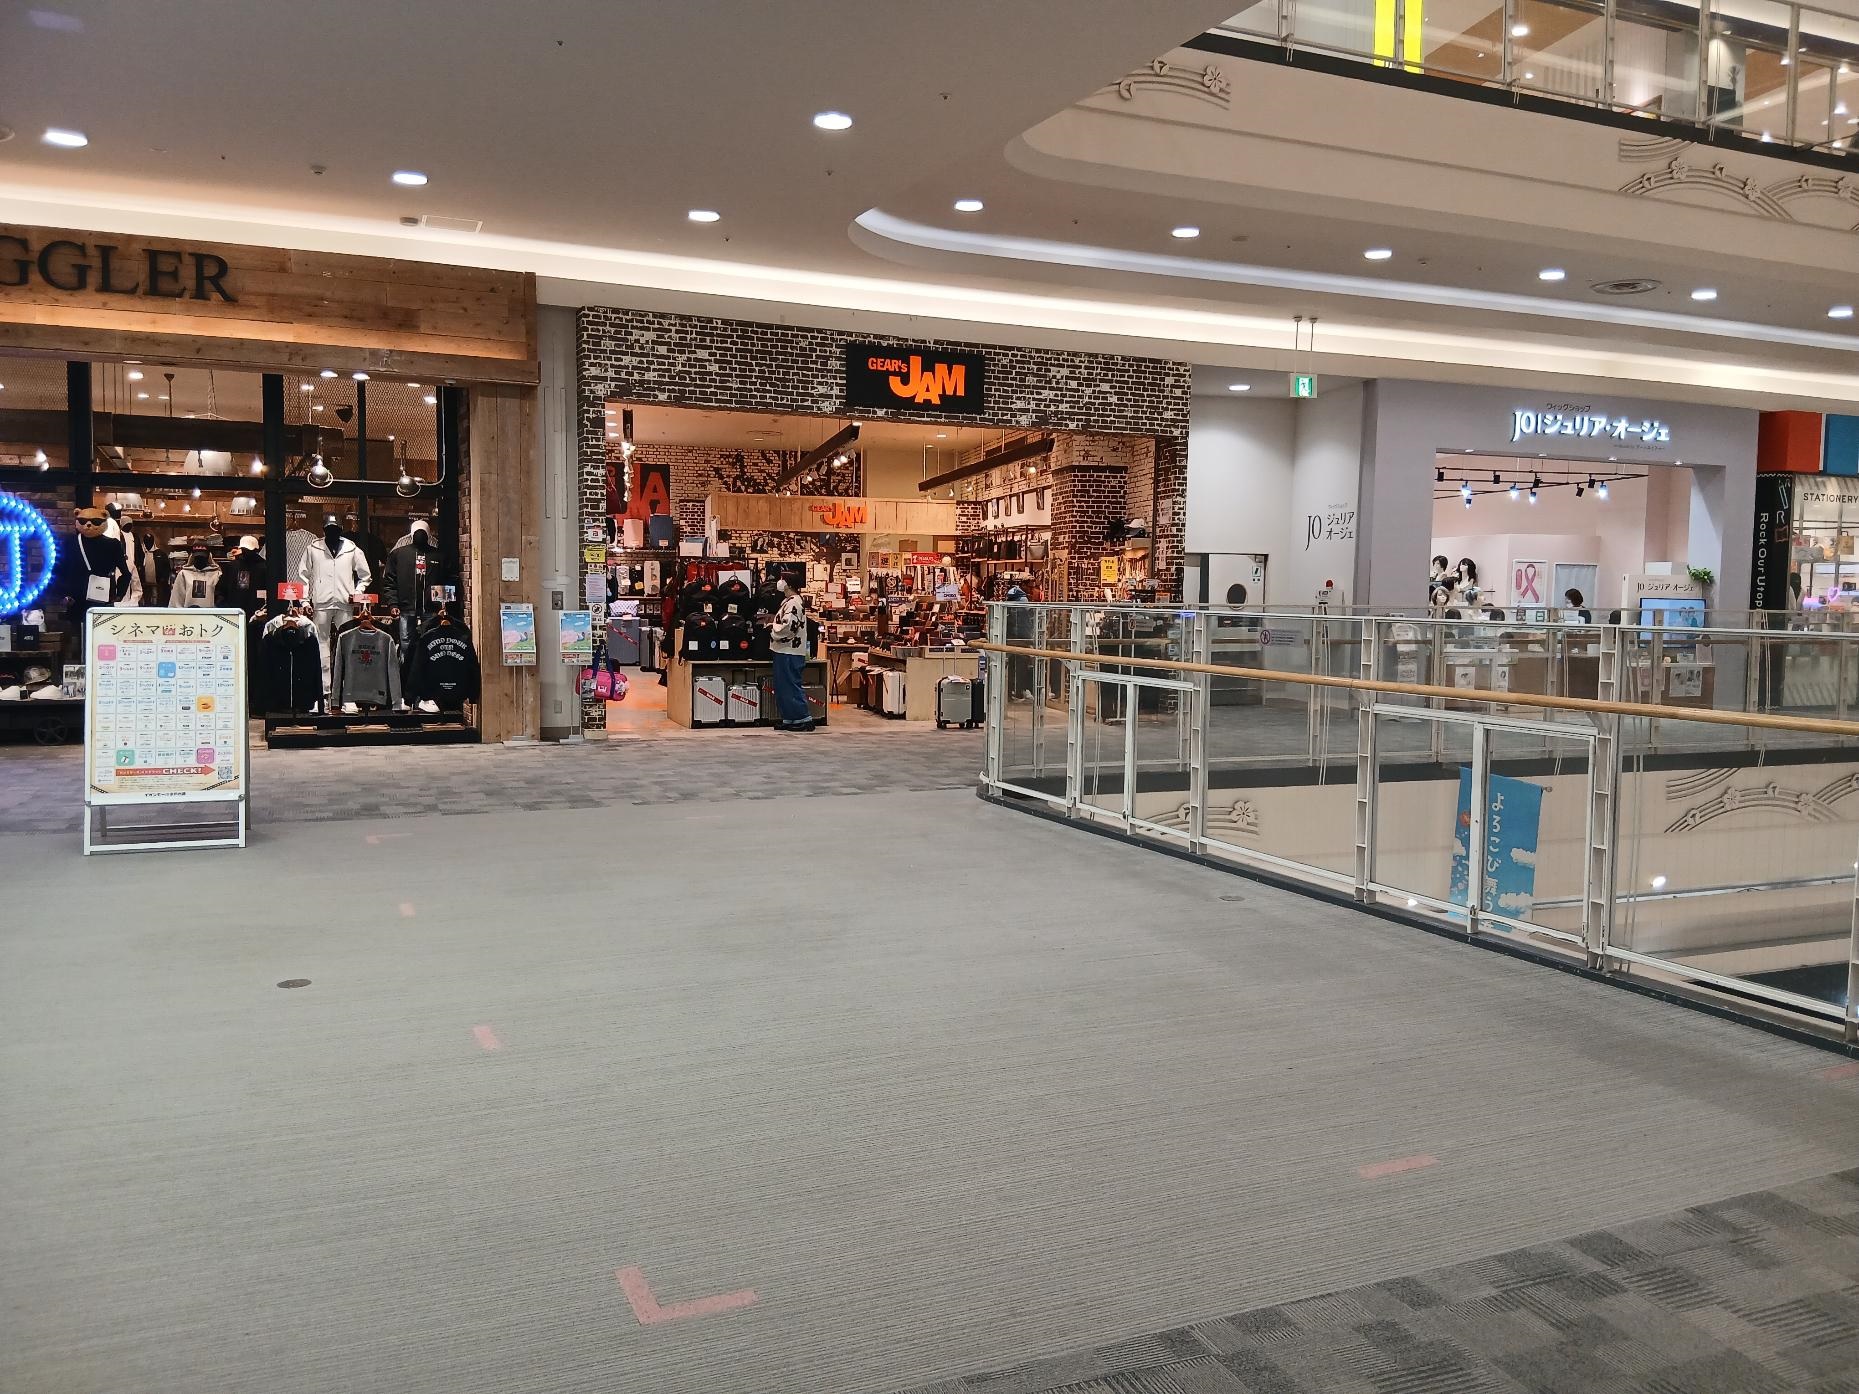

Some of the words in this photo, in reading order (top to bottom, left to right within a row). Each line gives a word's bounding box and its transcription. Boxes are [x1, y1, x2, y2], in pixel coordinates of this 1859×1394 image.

[888, 355, 966, 405] JAM
[1803, 492, 1859, 504] STATIONERY
[821, 501, 868, 529] JAM
[1327, 512, 1355, 526] ジュリア
[1759, 512, 1768, 545] Rock
[1305, 514, 1322, 551] JO
[1326, 527, 1355, 540] オージェ
[1757, 548, 1767, 574] Our
